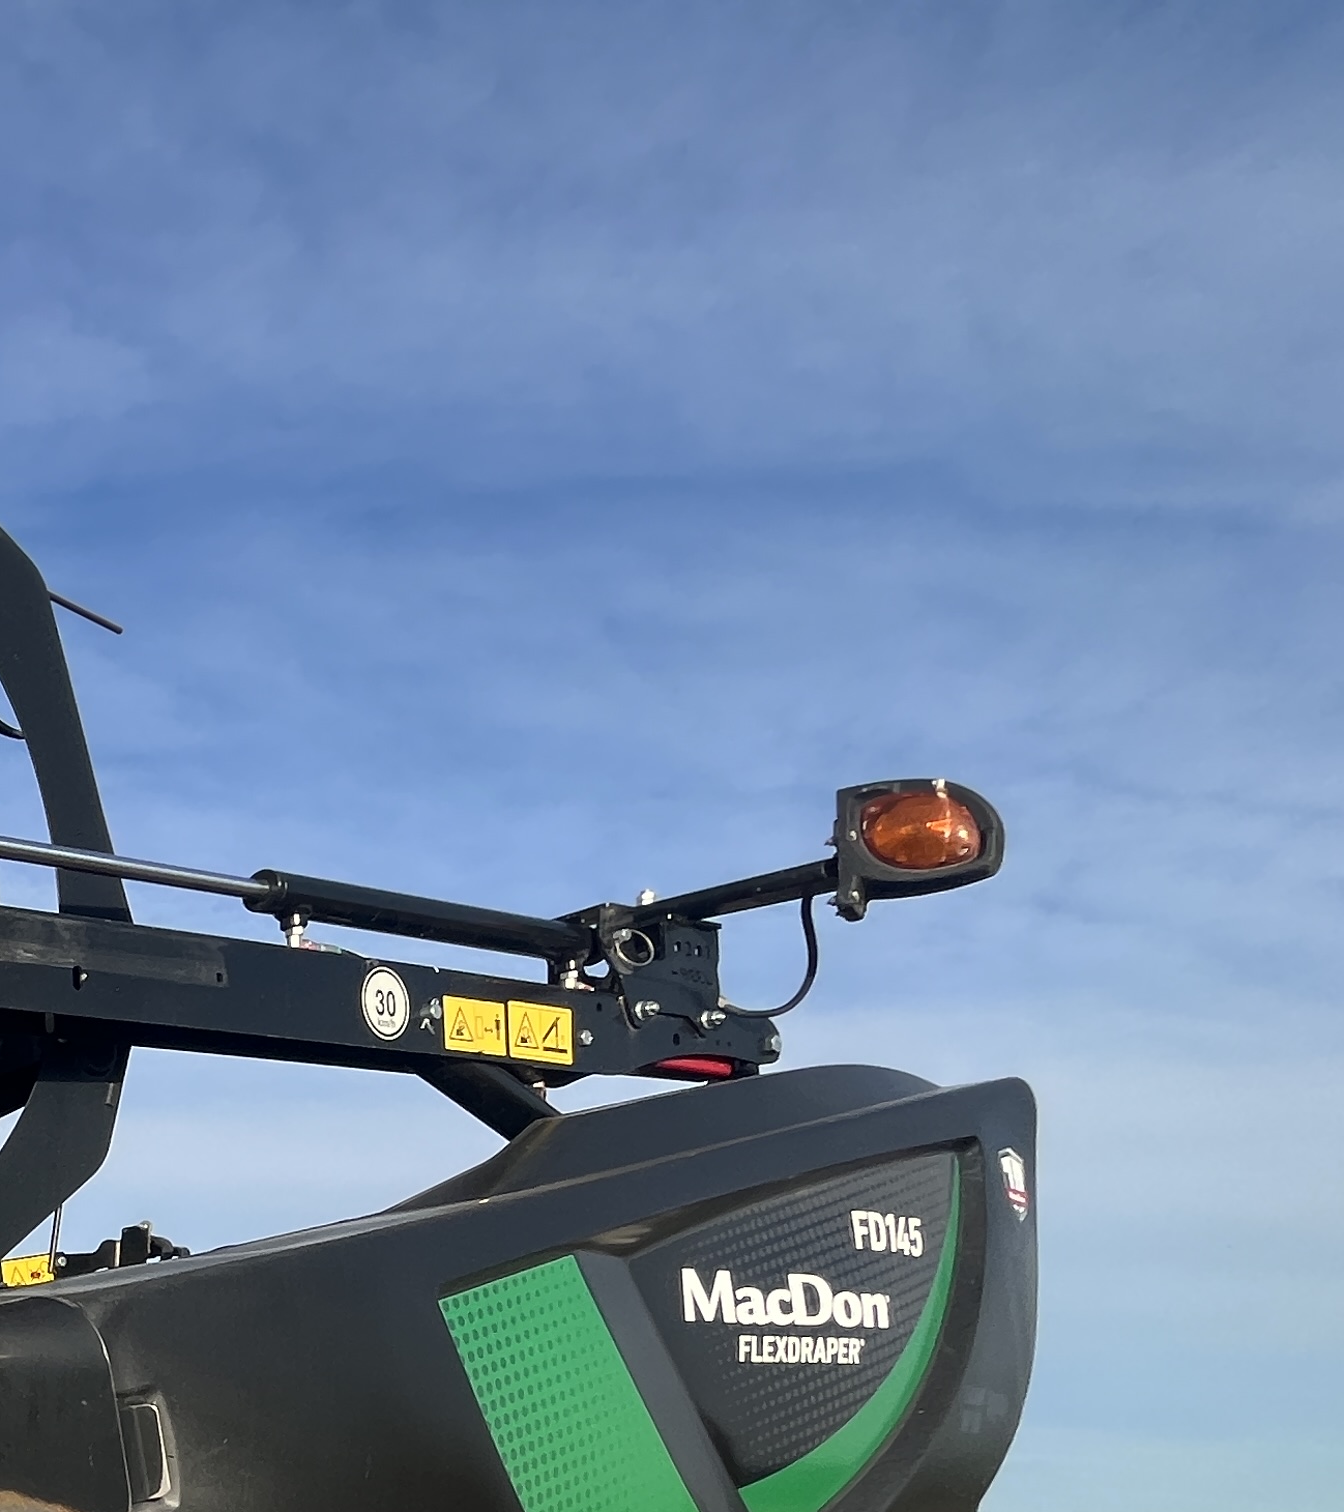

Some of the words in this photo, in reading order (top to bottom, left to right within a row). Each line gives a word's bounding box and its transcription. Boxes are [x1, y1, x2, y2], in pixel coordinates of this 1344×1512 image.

[376, 989, 396, 1017] 30
[850, 1210, 924, 1257] FD145
[681, 1268, 889, 1329] MacDon
[738, 1335, 864, 1364] FLEXDRAPER
